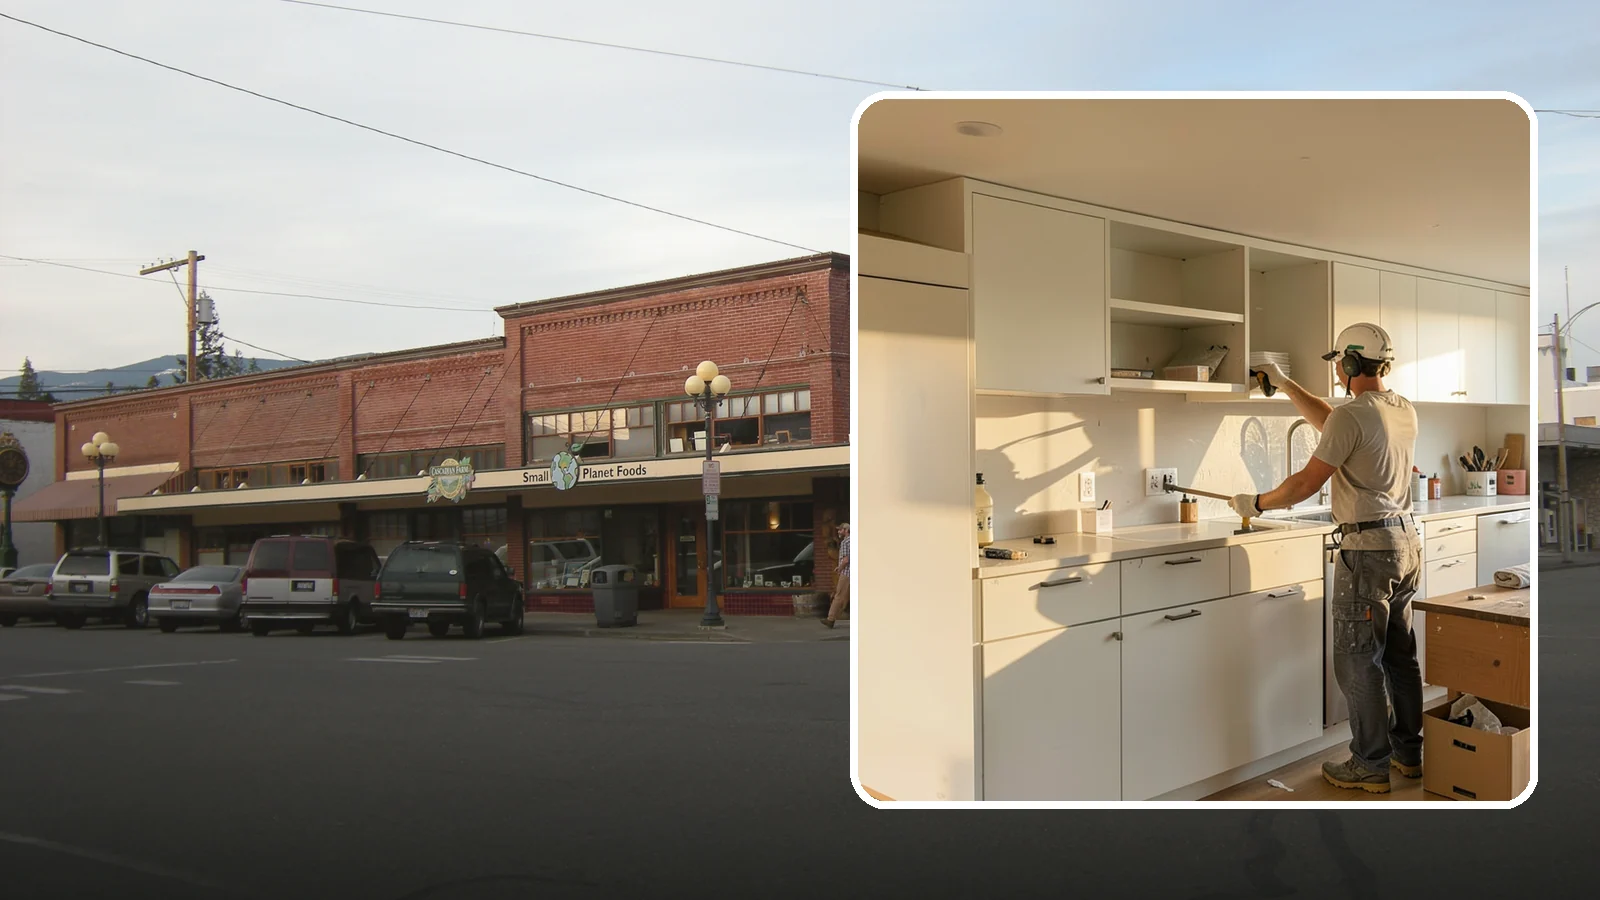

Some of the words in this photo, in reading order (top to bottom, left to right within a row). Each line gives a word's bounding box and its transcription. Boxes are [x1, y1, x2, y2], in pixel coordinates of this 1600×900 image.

[431, 467, 455, 475] CASCADIAN
[455, 466, 469, 474] FARM
[523, 471, 549, 482] Small
[582, 467, 614, 479] Planet
[616, 464, 647, 477] Foods
